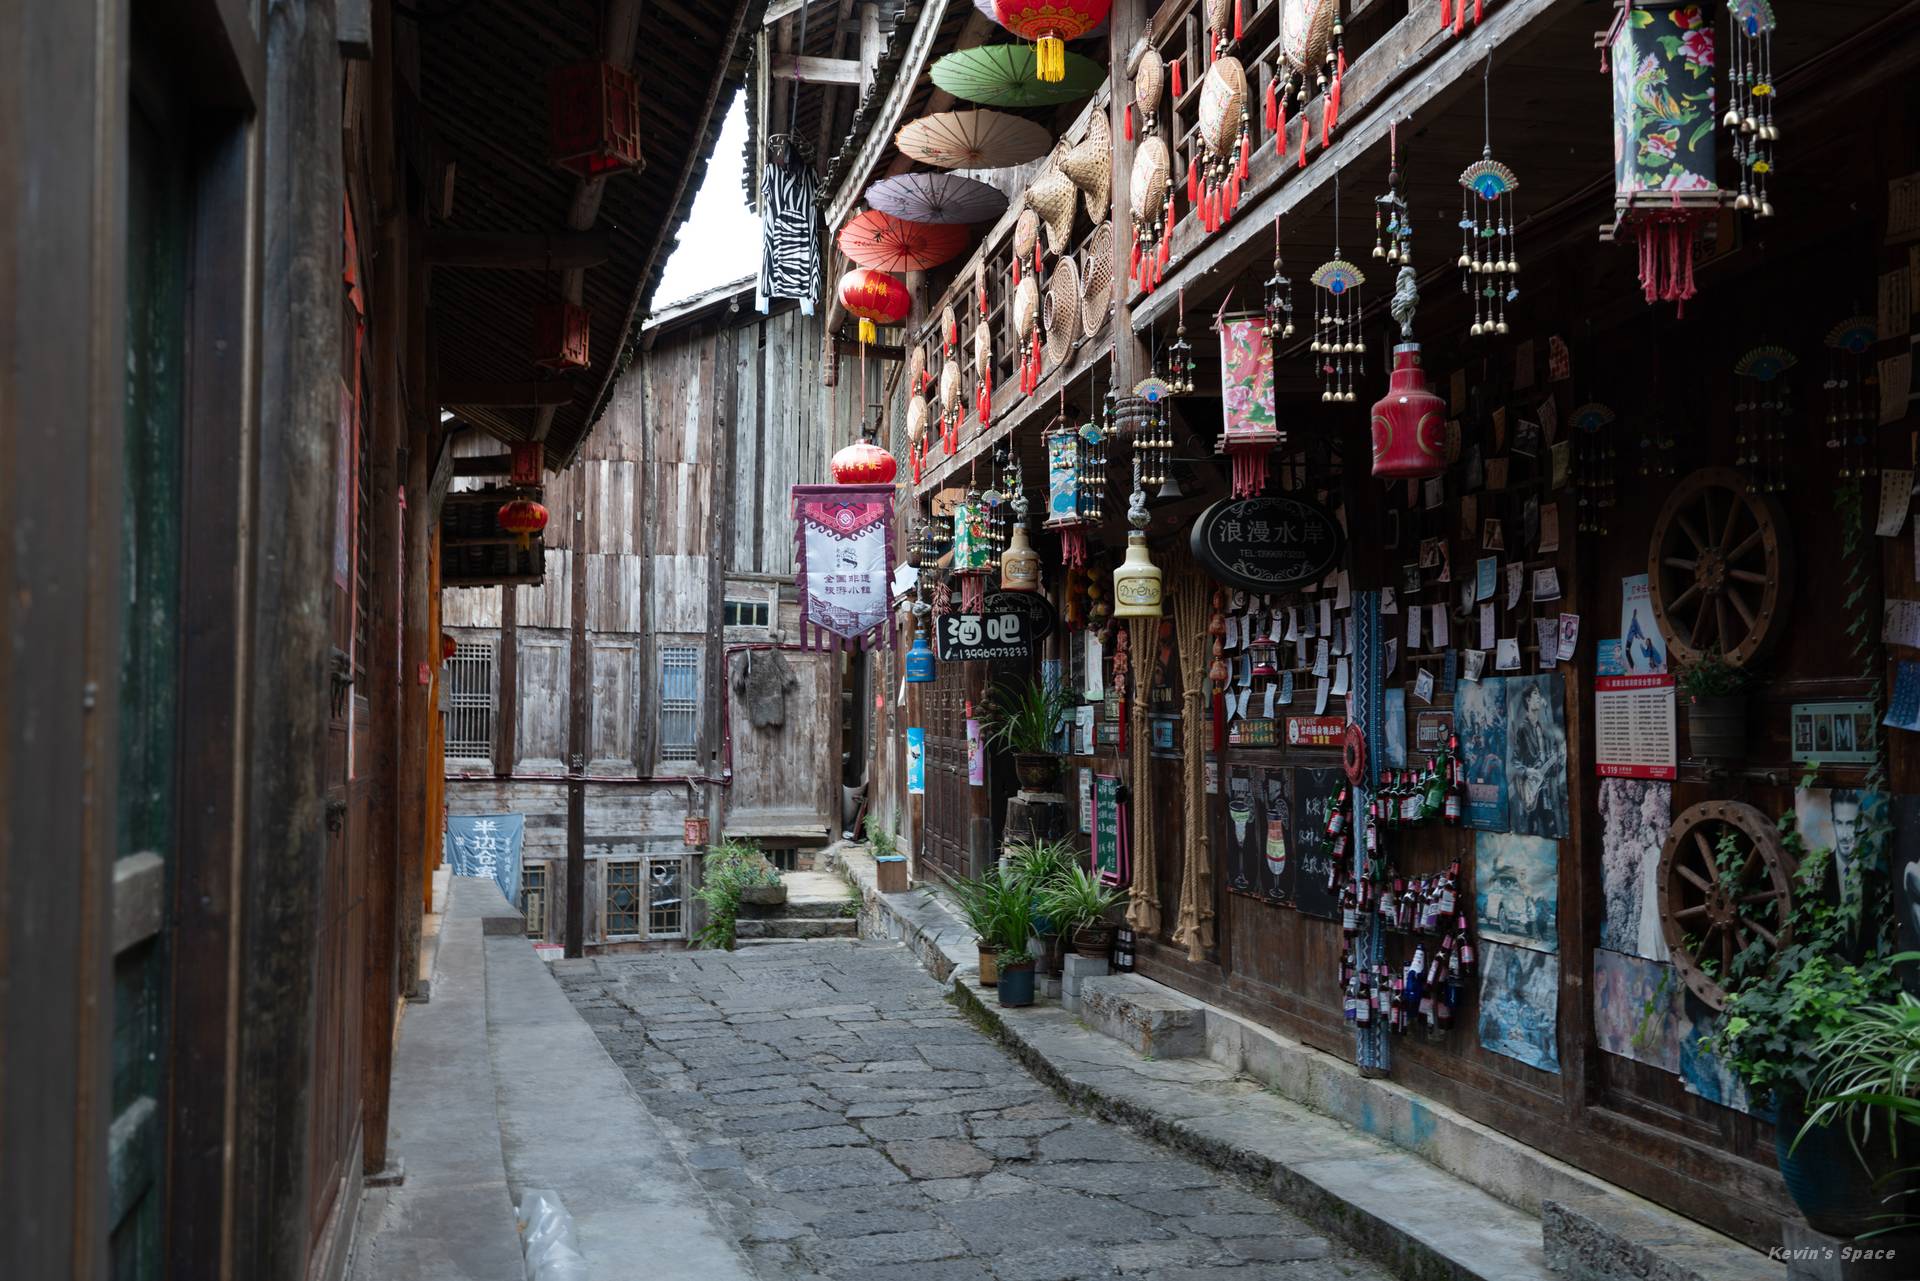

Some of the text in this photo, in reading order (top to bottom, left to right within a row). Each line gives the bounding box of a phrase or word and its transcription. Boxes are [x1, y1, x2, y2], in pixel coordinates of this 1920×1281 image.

[1218, 519, 1326, 545] 浪漫水岸
[946, 614, 1021, 646] 酒吧
[958, 643, 1028, 660] 13996973233
